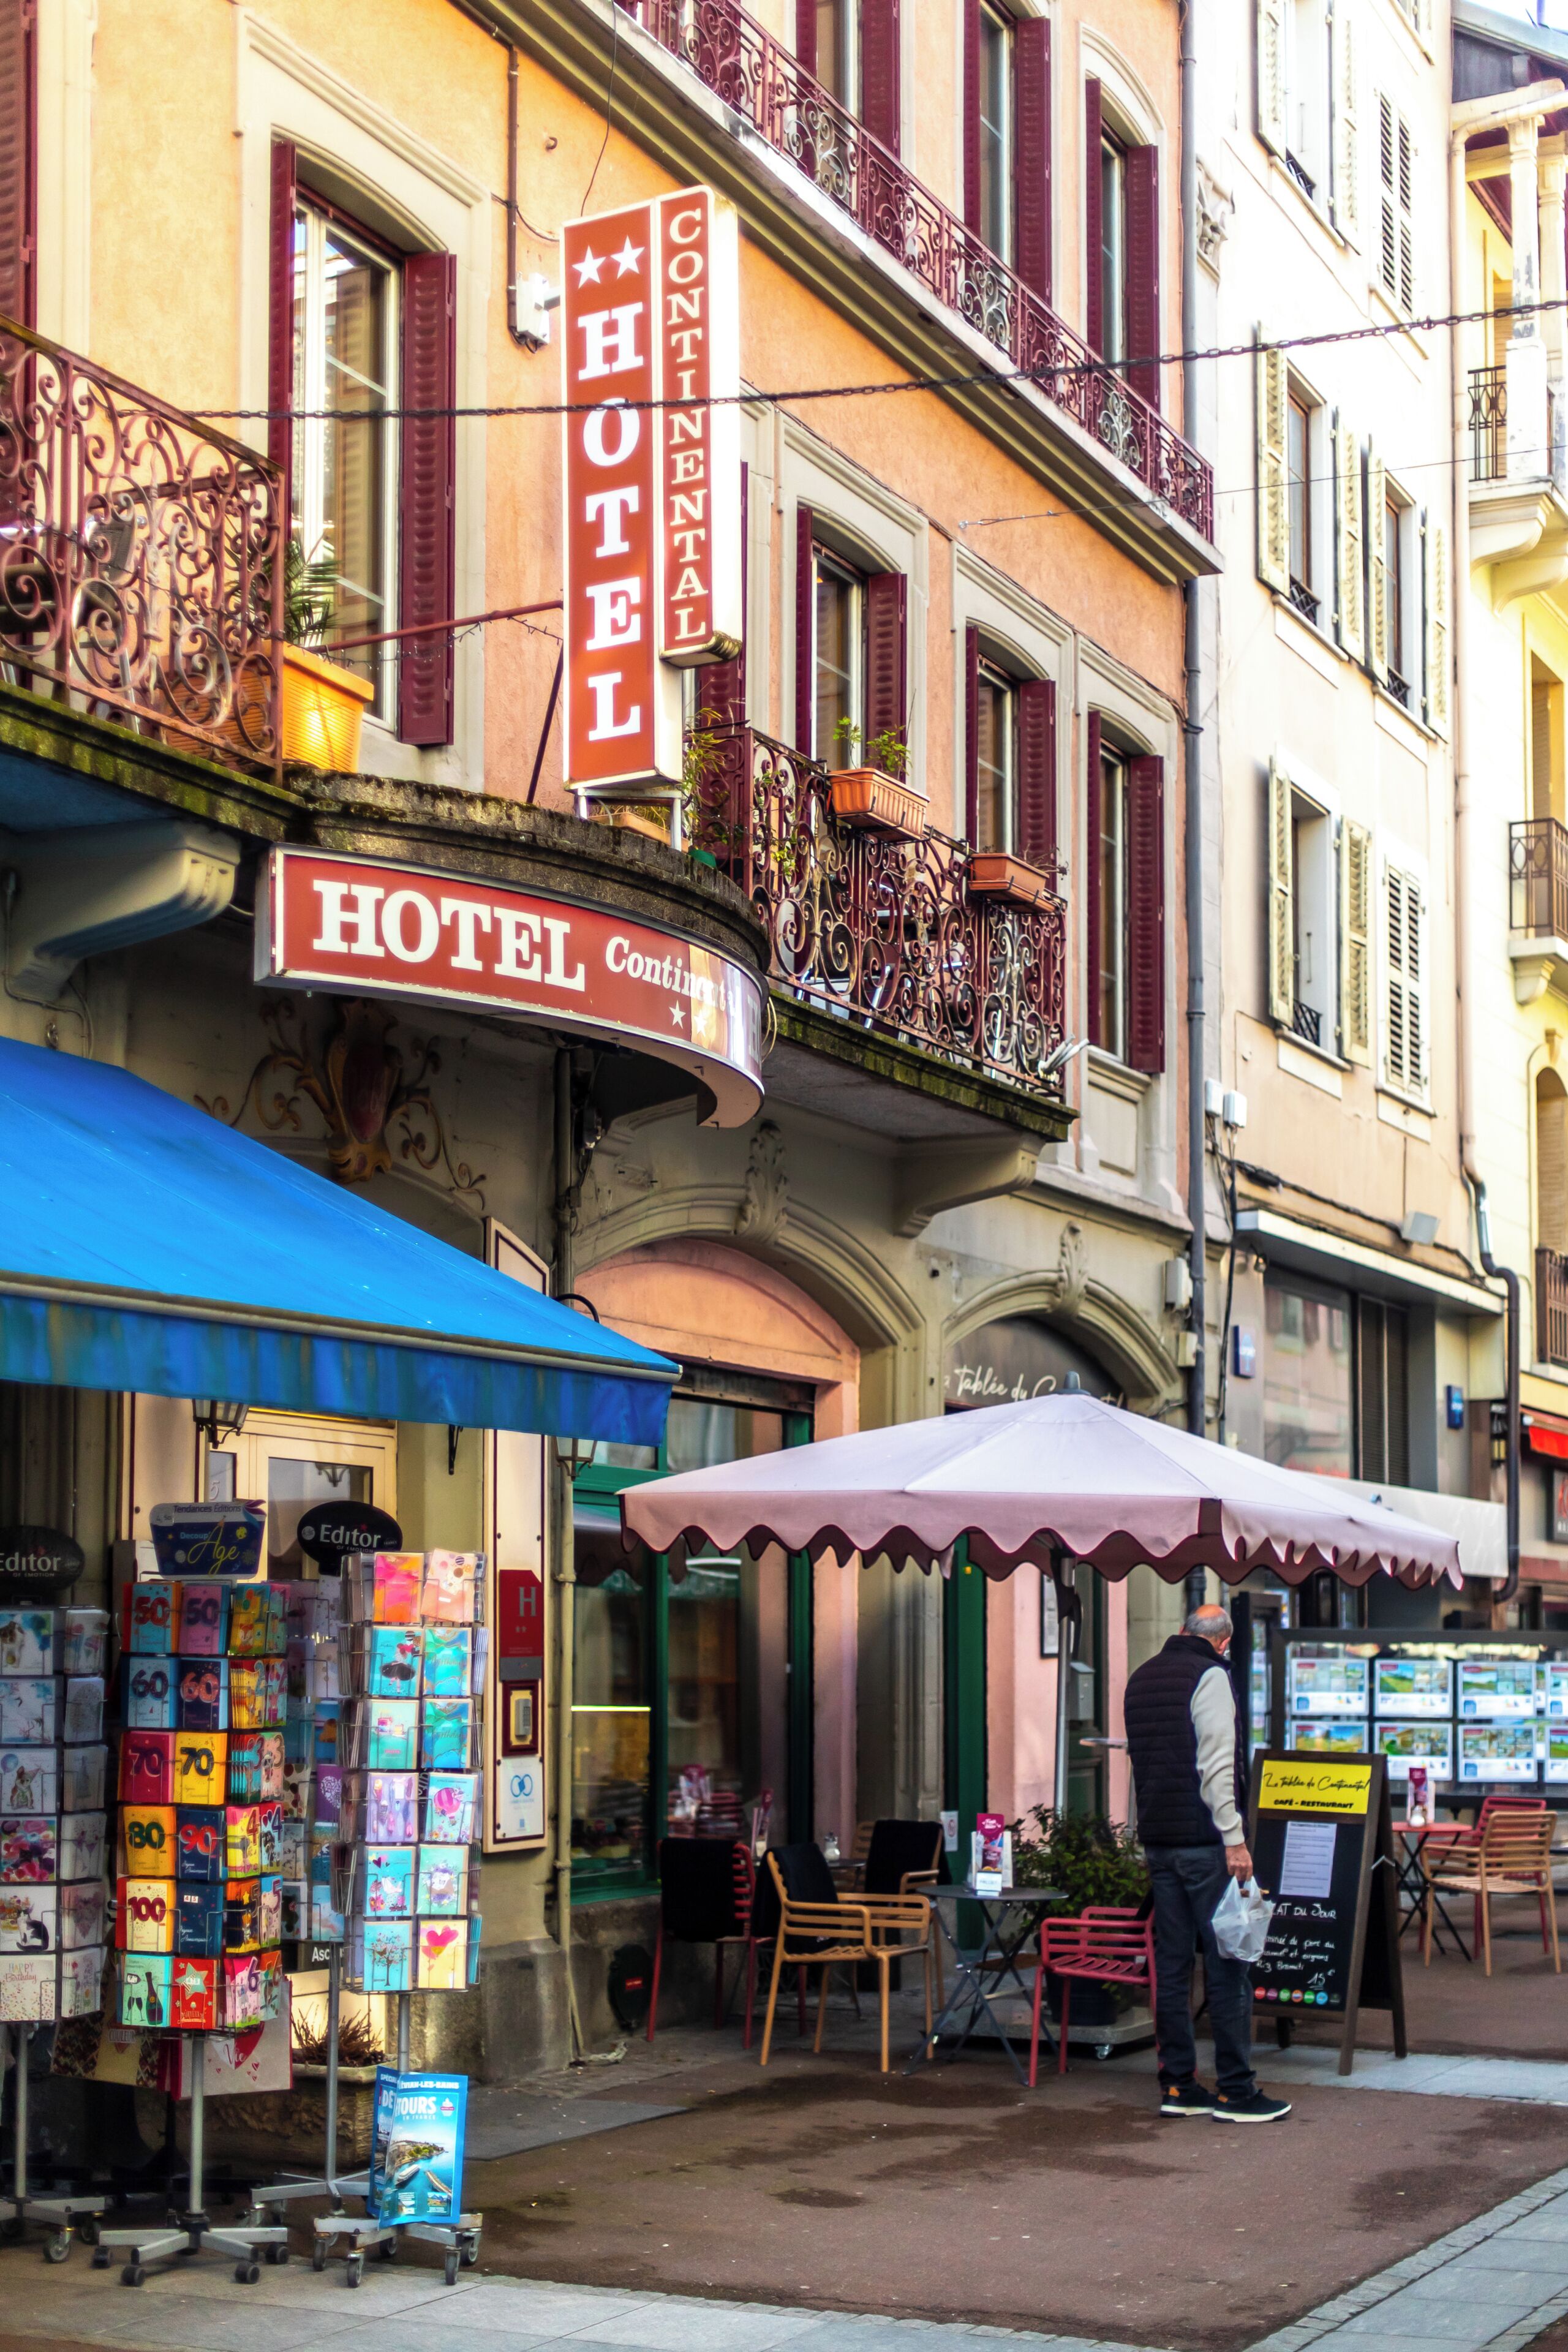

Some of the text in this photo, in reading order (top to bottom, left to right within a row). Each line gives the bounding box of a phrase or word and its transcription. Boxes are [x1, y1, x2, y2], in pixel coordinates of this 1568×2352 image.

[668, 208, 709, 641] CONTINENTAL
[578, 301, 644, 742] HOTEL
[312, 879, 586, 992] HOTEL
[954, 1364, 1009, 1397] Tablée
[173, 1503, 241, 1513] Tendances Éditions
[319, 1524, 382, 1548] Editor
[134, 1596, 170, 1627] 50
[186, 1597, 219, 1626] 50
[519, 1586, 537, 1617] H
[131, 1669, 169, 1699] 60
[180, 1672, 221, 1703] 60
[128, 1747, 164, 1777] 70
[180, 1747, 214, 1776] 70
[1317, 1776, 1371, 1792] Continental
[1300, 1800, 1354, 1809] RESTAURANT
[128, 1821, 165, 1850] 80
[179, 1823, 217, 1855] 90
[127, 1896, 167, 1923] 100
[6, 1972, 37, 1985] Birthday
[9, 1962, 34, 1973] HAPPY
[247, 1956, 260, 1992] 6
[222, 2043, 246, 2062] Vie
